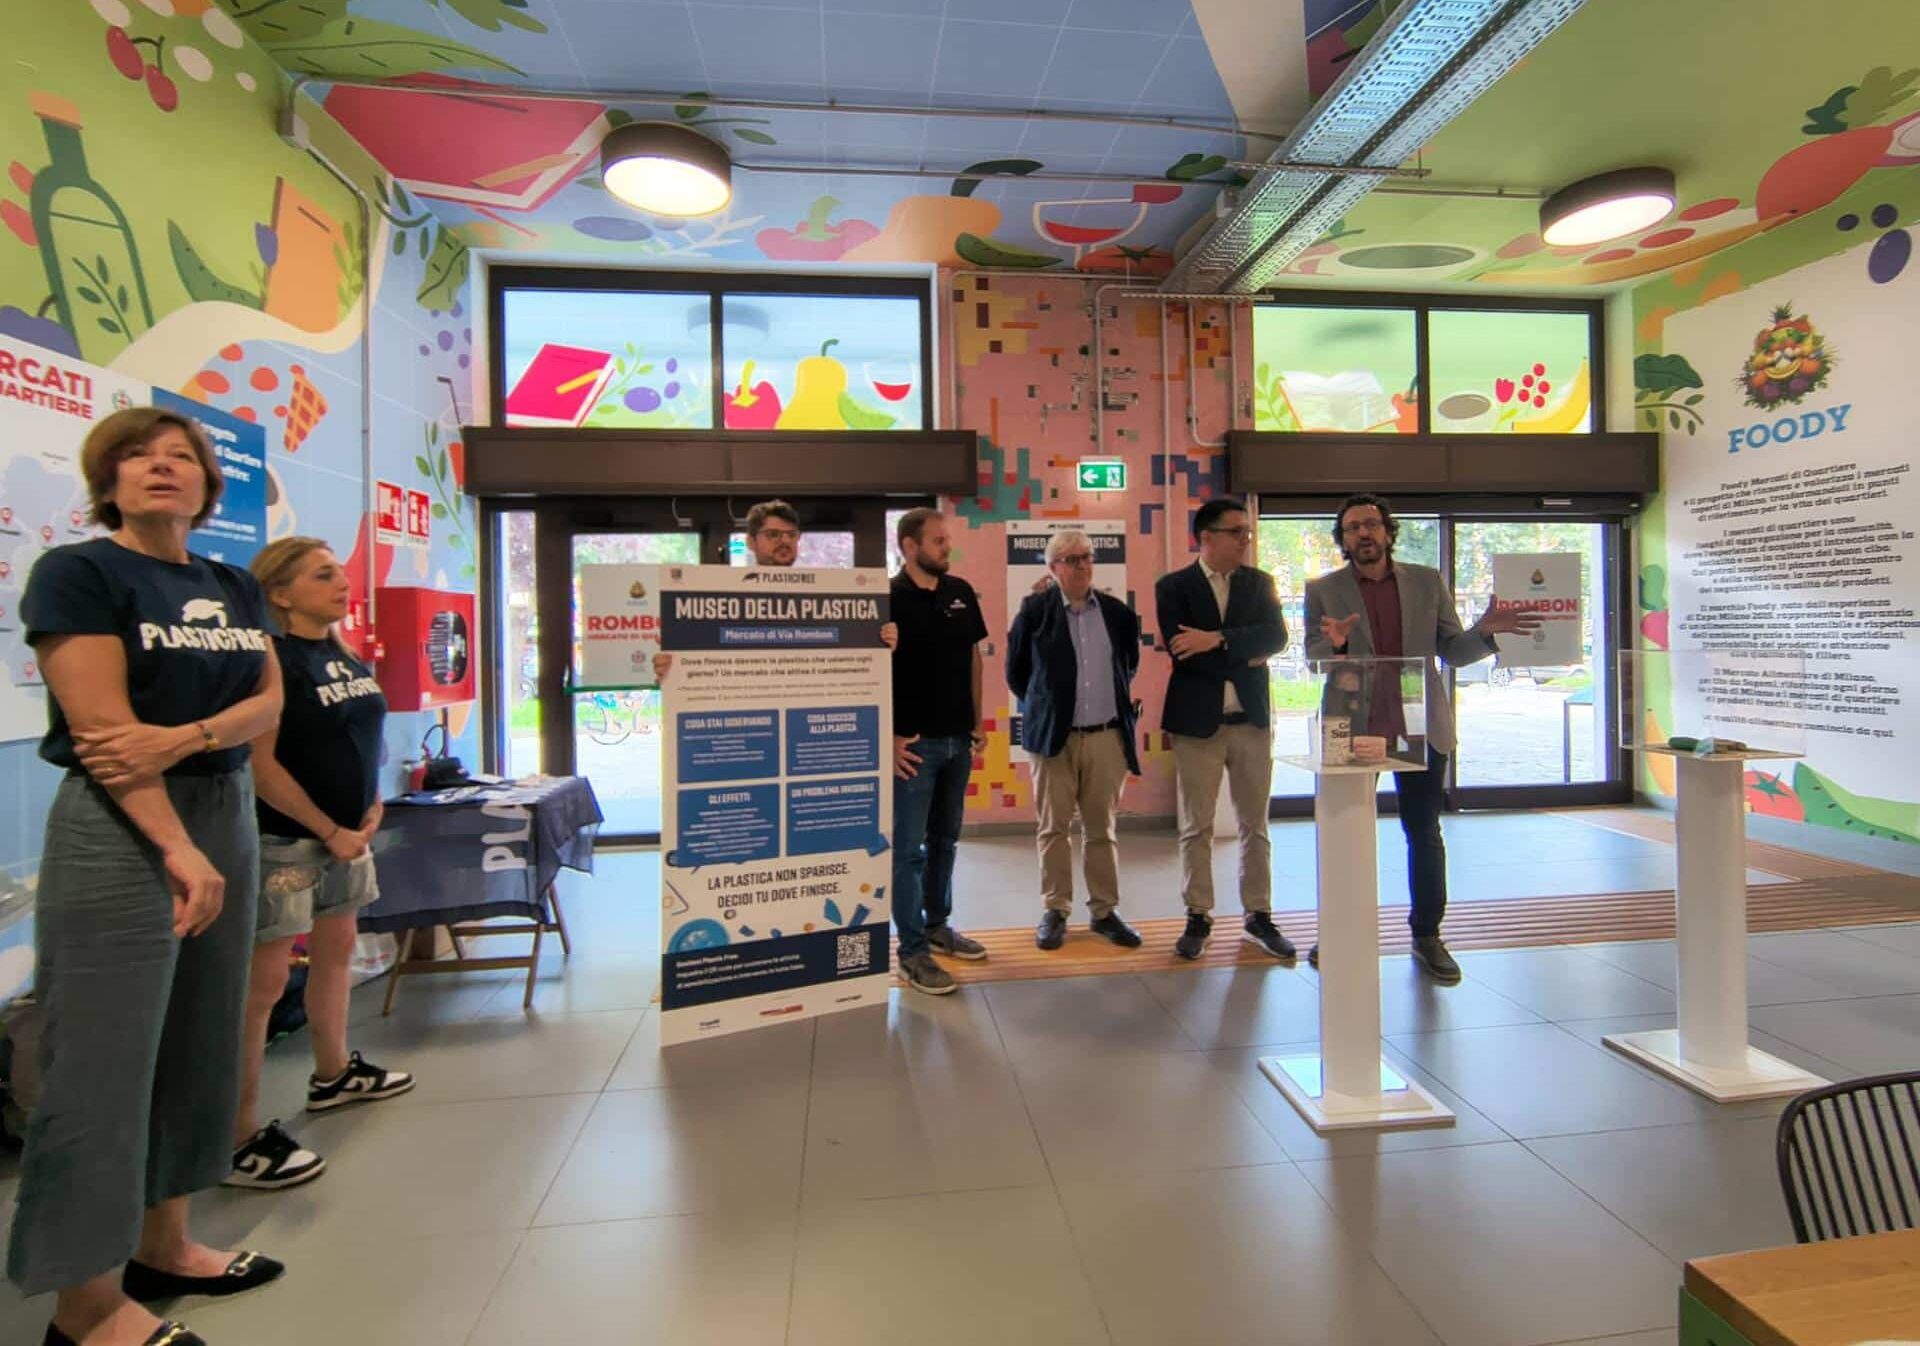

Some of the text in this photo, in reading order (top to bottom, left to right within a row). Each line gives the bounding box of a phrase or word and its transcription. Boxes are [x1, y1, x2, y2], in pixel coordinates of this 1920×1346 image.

[1728, 404, 1852, 453] FOODY
[1720, 479, 1748, 490] Foody
[1751, 472, 1789, 485] Mercati
[1803, 464, 1856, 479] Quartiere
[1802, 475, 1854, 488] valorizza
[1864, 464, 1910, 479] mercati
[1868, 476, 1900, 490] punti
[1792, 500, 1813, 509] vita
[1778, 520, 1827, 532] quartiere
[1830, 516, 1856, 525] sono
[1824, 535, 1874, 546] intreccia
[1775, 552, 1813, 560] cultura
[1788, 562, 1828, 571] piacere
[1806, 569, 1872, 579] competenza
[676, 597, 879, 621] MUSEO DELLA PLASTICA
[1858, 610, 1913, 619] garanzia
[726, 630, 765, 639] Mercato
[767, 630, 777, 639] di
[779, 630, 793, 639] Via
[1860, 684, 1898, 693] giorno
[1844, 696, 1900, 705] quartiere
[708, 863, 850, 891] LA PLASTICA NON SPARISCE.
[718, 882, 842, 909] DECIDI TU DOVE FINISCE.
